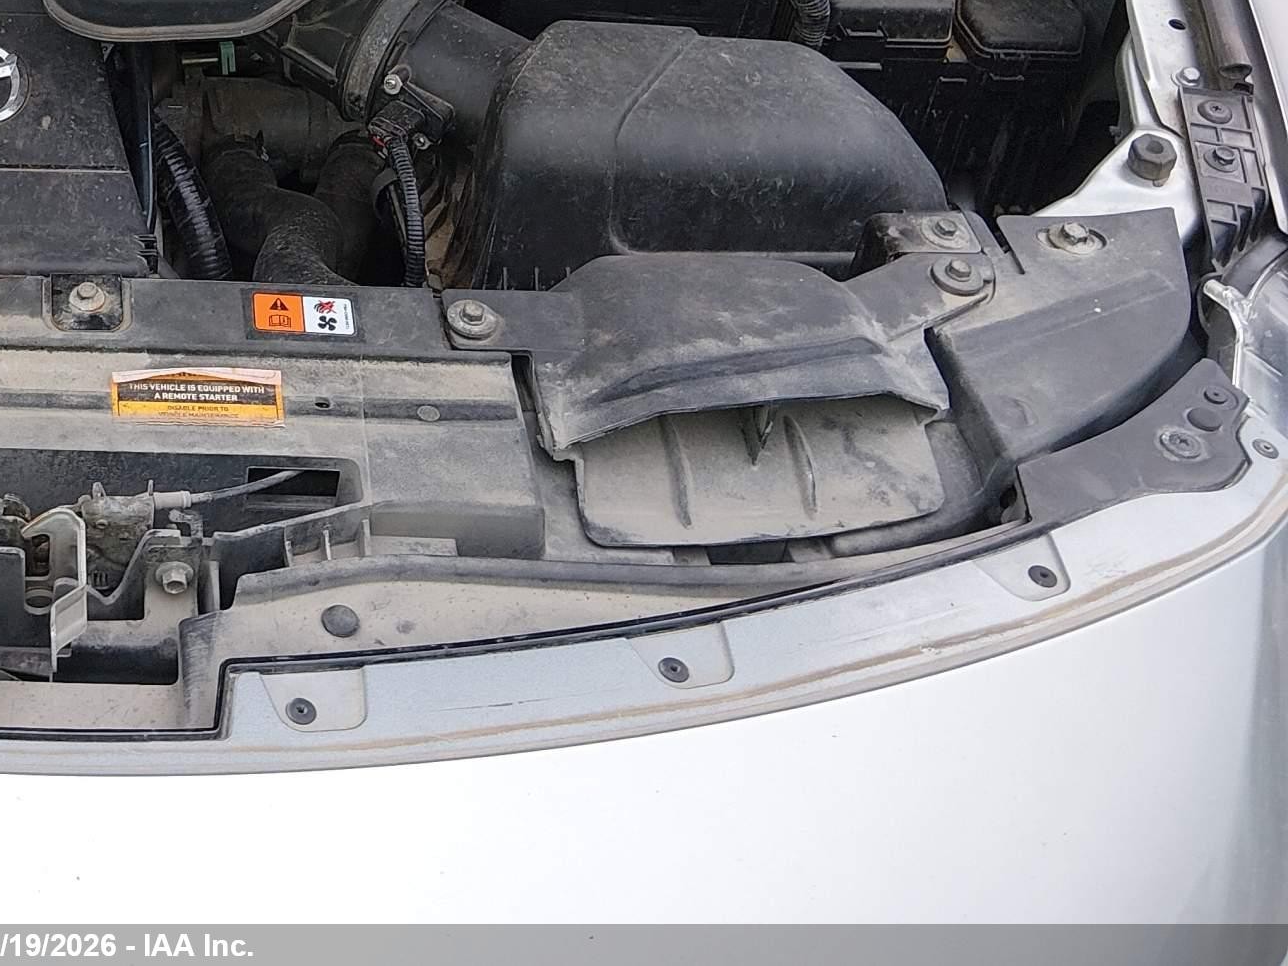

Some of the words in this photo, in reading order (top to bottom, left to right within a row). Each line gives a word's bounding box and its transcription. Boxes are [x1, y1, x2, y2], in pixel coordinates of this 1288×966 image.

[187, 384, 196, 392] IS
[198, 384, 241, 393] EQUIPPED
[198, 393, 238, 401] STARTER
